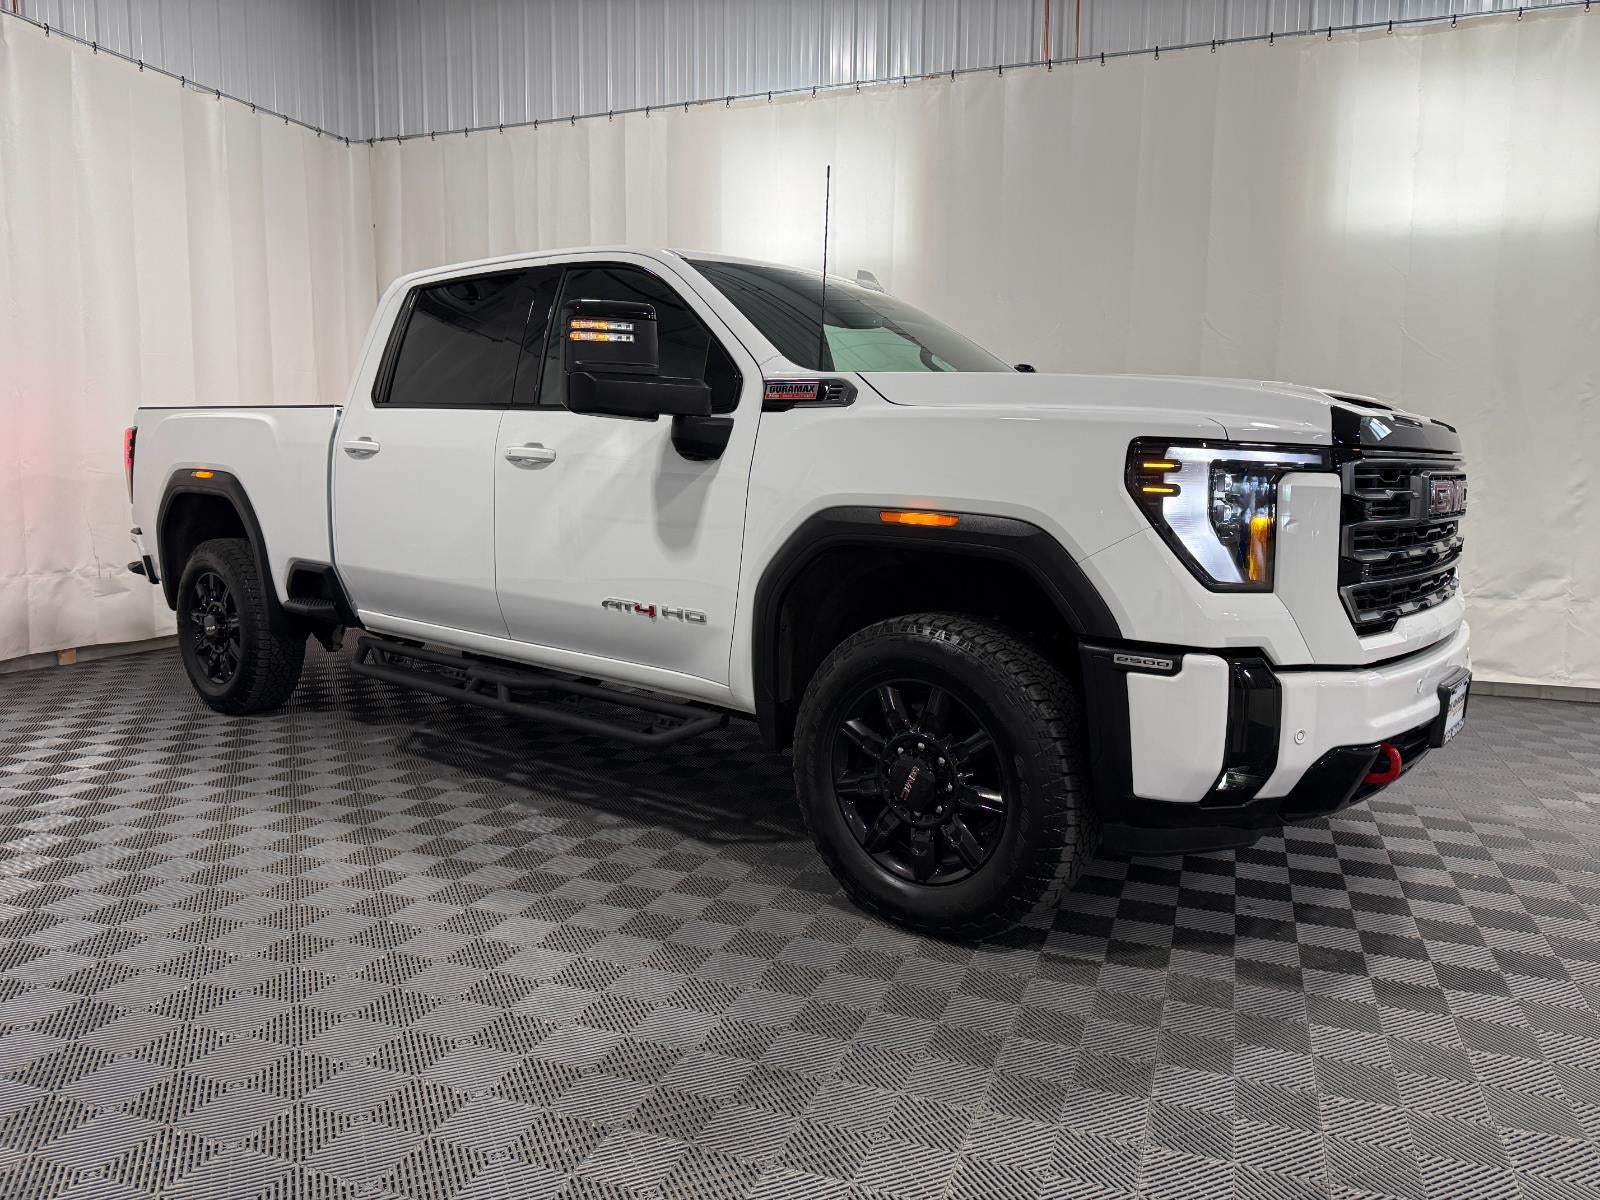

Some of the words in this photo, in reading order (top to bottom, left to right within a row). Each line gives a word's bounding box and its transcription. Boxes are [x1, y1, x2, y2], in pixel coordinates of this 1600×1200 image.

[768, 384, 816, 394] DURAMAX
[661, 605, 707, 624] HD
[1113, 653, 1173, 670] 2500
[900, 766, 920, 800] GMC
